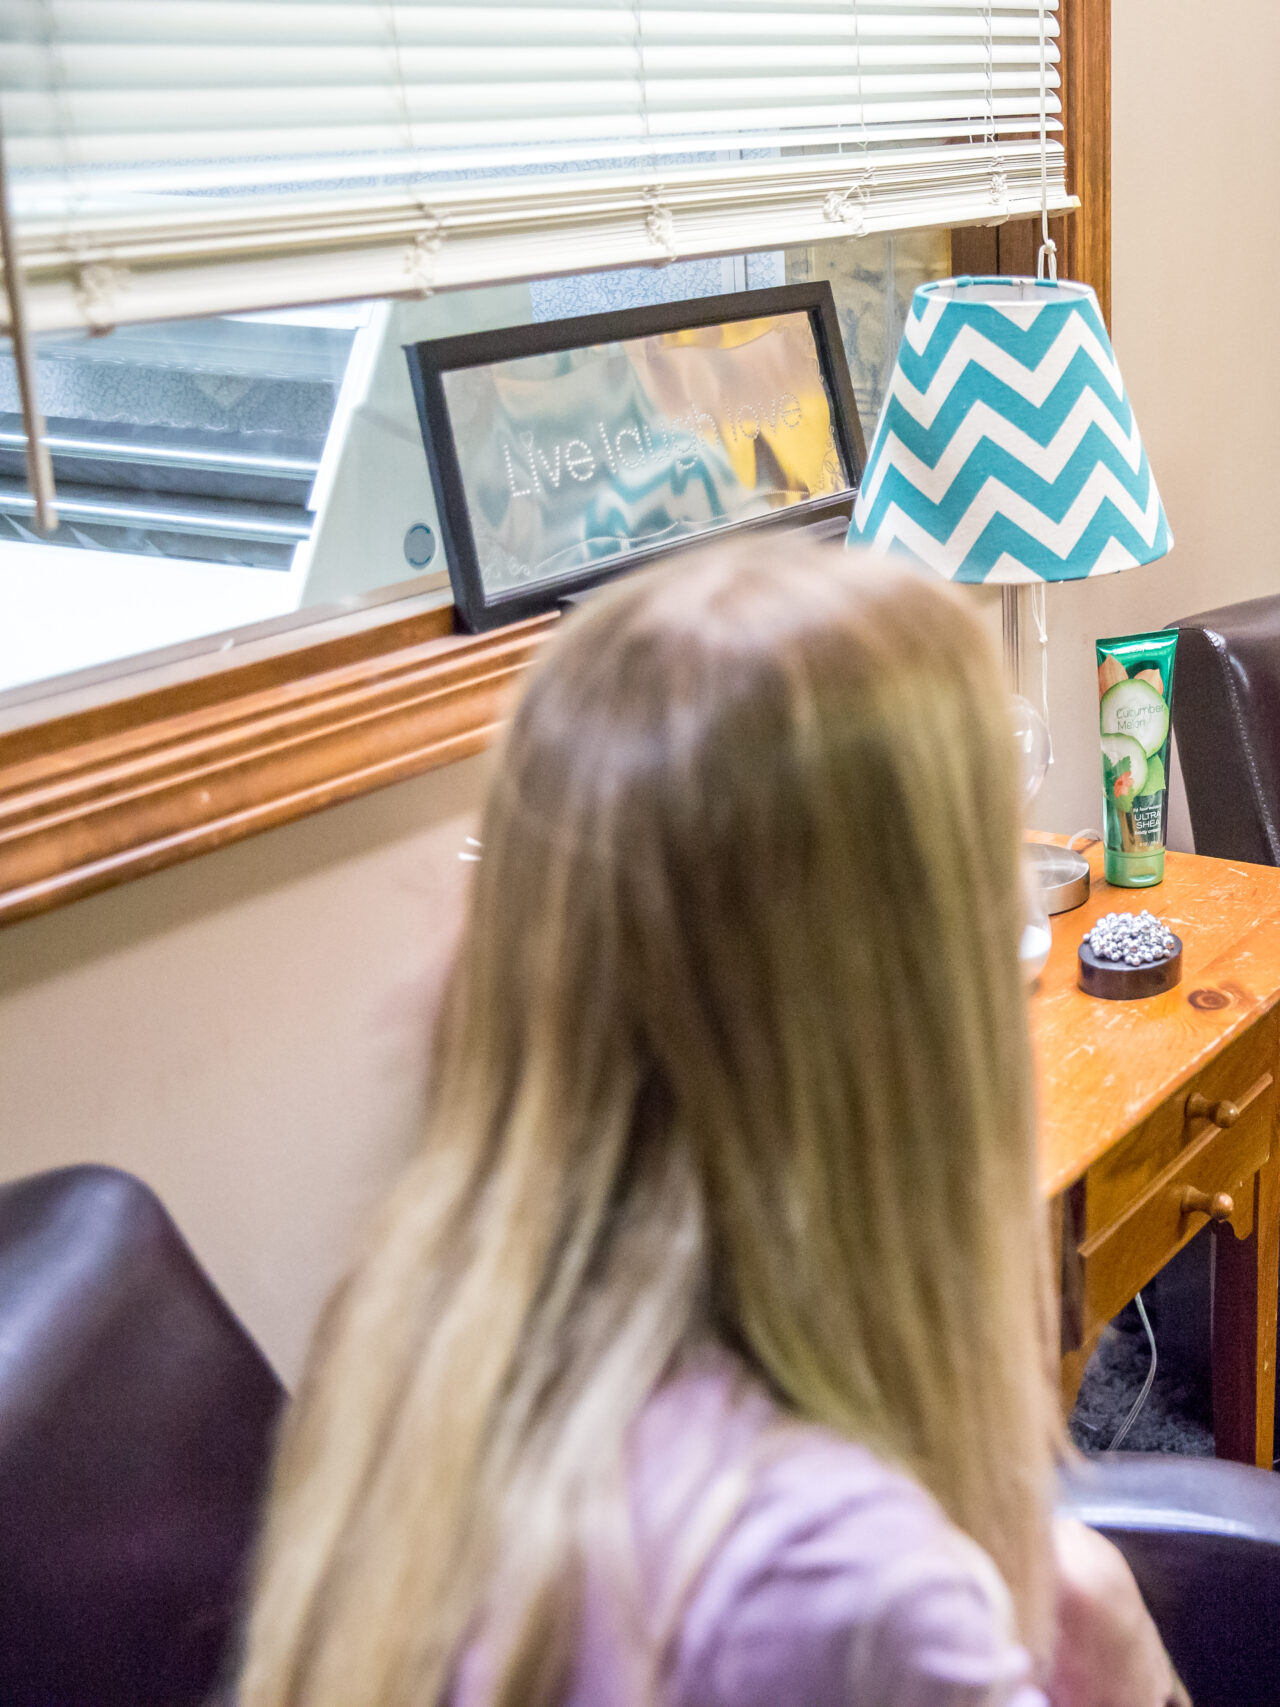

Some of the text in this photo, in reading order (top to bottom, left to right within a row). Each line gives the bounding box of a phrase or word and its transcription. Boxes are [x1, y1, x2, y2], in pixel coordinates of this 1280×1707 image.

[1116, 704, 1164, 719] Cucumber
[1117, 719, 1146, 731] Melon
[1134, 811, 1161, 821] ULTRA
[1136, 819, 1160, 829] SHEA
